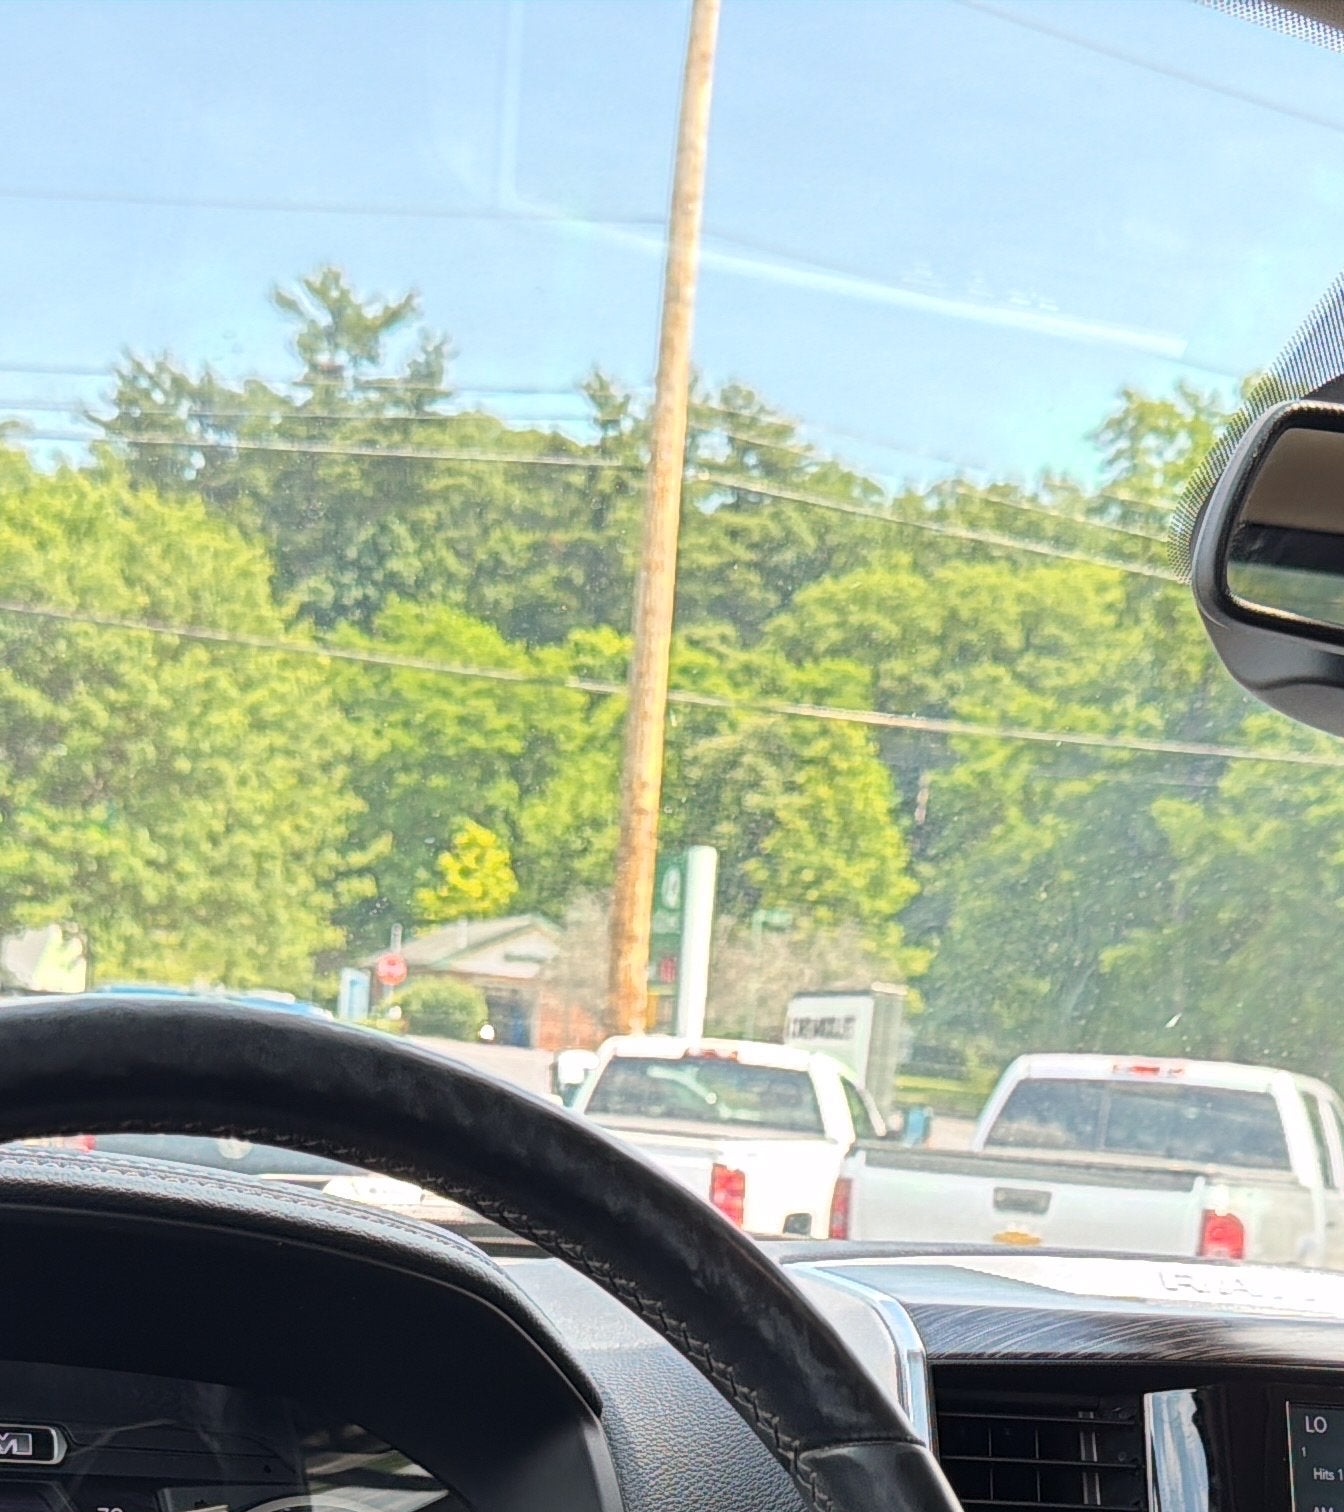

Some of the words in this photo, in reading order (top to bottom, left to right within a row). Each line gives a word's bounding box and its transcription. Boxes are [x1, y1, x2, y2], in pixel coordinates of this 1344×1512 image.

[1305, 1415, 1328, 1434] LO
[1313, 1467, 1335, 1480] Hits
[1337, 1468, 1344, 1481] 1
